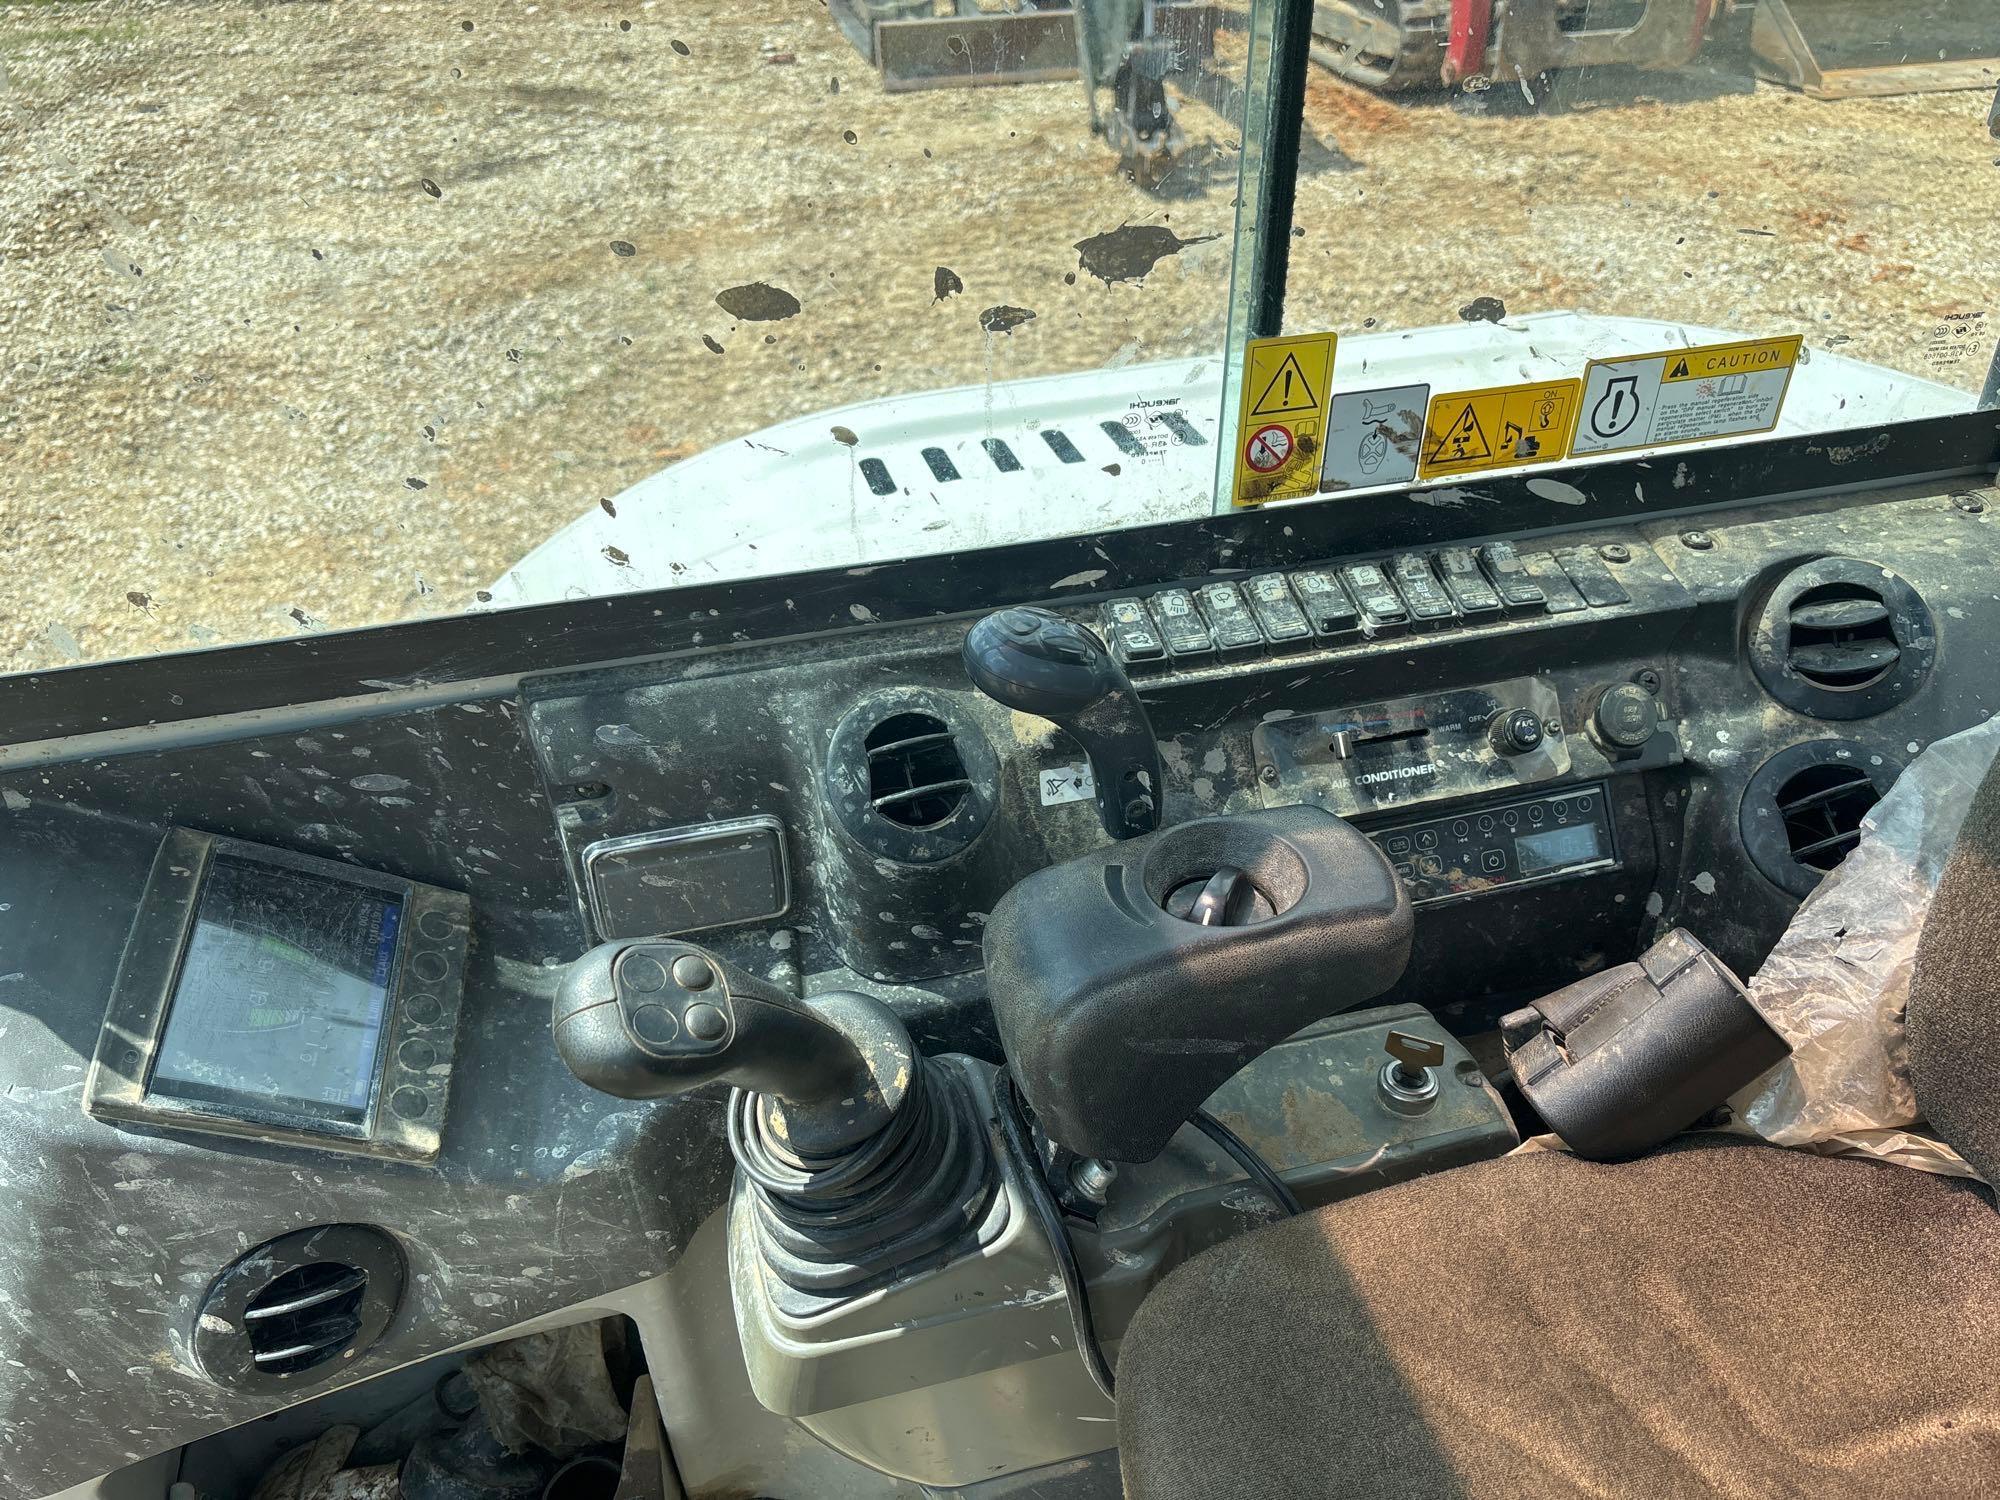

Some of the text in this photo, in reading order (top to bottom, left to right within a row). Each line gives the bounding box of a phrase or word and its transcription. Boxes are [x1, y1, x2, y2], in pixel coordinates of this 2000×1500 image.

[1706, 350, 1781, 370] CAUTION
[1543, 390, 1558, 399] ON
[1468, 714, 1482, 724] OFF
[1521, 718, 1535, 728] A/C
[1437, 723, 1462, 733] WARM
[1331, 763, 1437, 790] AIR CONDITIONER
